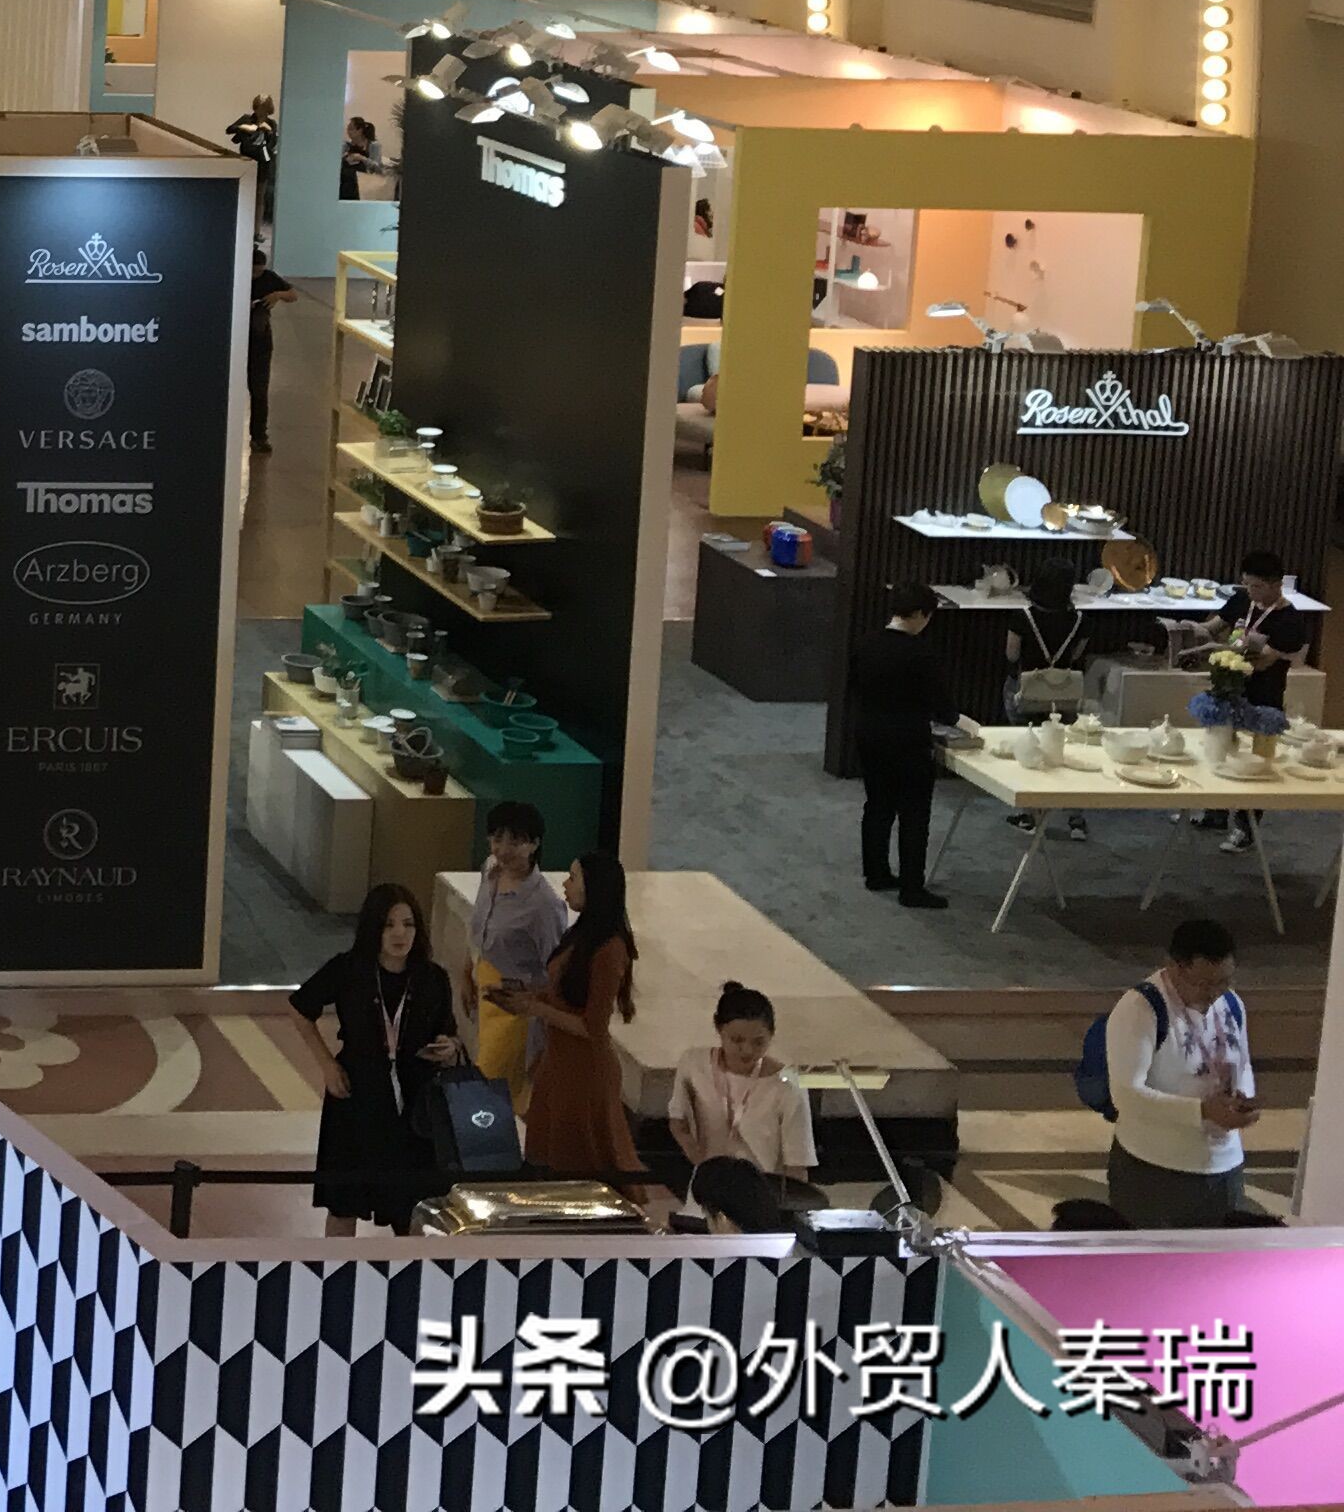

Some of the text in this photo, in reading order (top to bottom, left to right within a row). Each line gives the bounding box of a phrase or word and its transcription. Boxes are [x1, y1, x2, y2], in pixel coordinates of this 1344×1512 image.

[477, 135, 566, 208] Thomas
[25, 238, 163, 284] Rosenthal
[21, 315, 159, 343] sambonet
[1017, 376, 1190, 436] Rosenthal
[18, 429, 156, 450] VERSACE
[16, 481, 154, 515] Thomas
[22, 557, 141, 590] Arzberg
[28, 612, 123, 626] GERMANY
[6, 726, 144, 754] ERCUIS
[38, 762, 76, 773] PARIS
[1, 866, 138, 887] RAYNAUD
